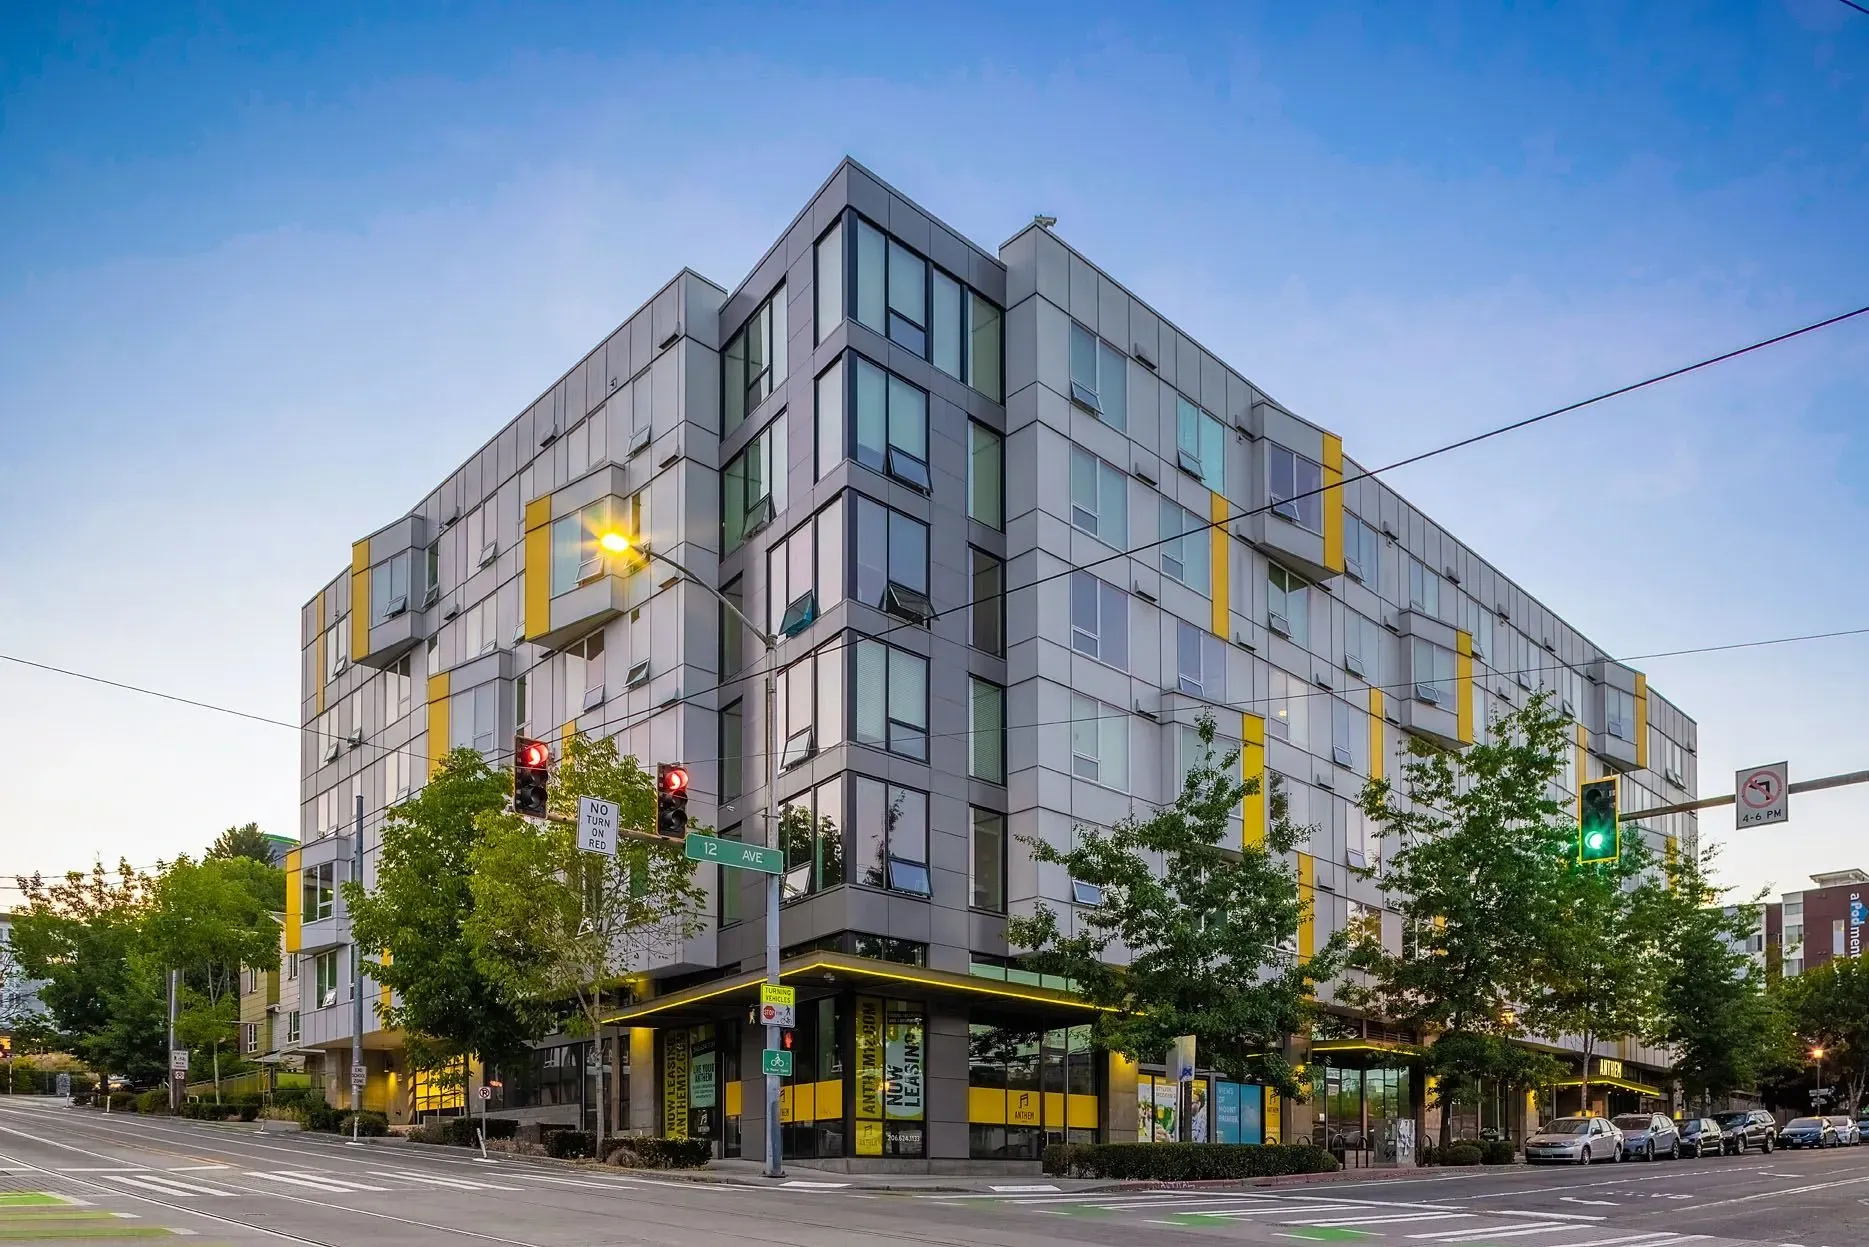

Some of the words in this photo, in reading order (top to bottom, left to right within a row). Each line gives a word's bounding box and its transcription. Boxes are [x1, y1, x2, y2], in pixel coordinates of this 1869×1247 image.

[590, 802, 609, 816] NO
[1742, 812, 1762, 823] 4-6
[1766, 808, 1782, 819] PM
[586, 814, 611, 828] TURN
[591, 828, 605, 838] ON
[588, 838, 607, 850] RED
[704, 841, 718, 856] 12
[742, 849, 763, 864] AVE
[765, 986, 792, 996] TURNING
[765, 994, 791, 1004] VEHICLES
[862, 1002, 876, 1115] ANTHM12.COM
[904, 1033, 921, 1108] LEASING
[1599, 1058, 1622, 1079] ANTHEM
[886, 1064, 904, 1107] NOW
[667, 1099, 676, 1132] NOW
[1014, 1110, 1036, 1121] ANTHEM
[1218, 1106, 1237, 1114] MOUNT
